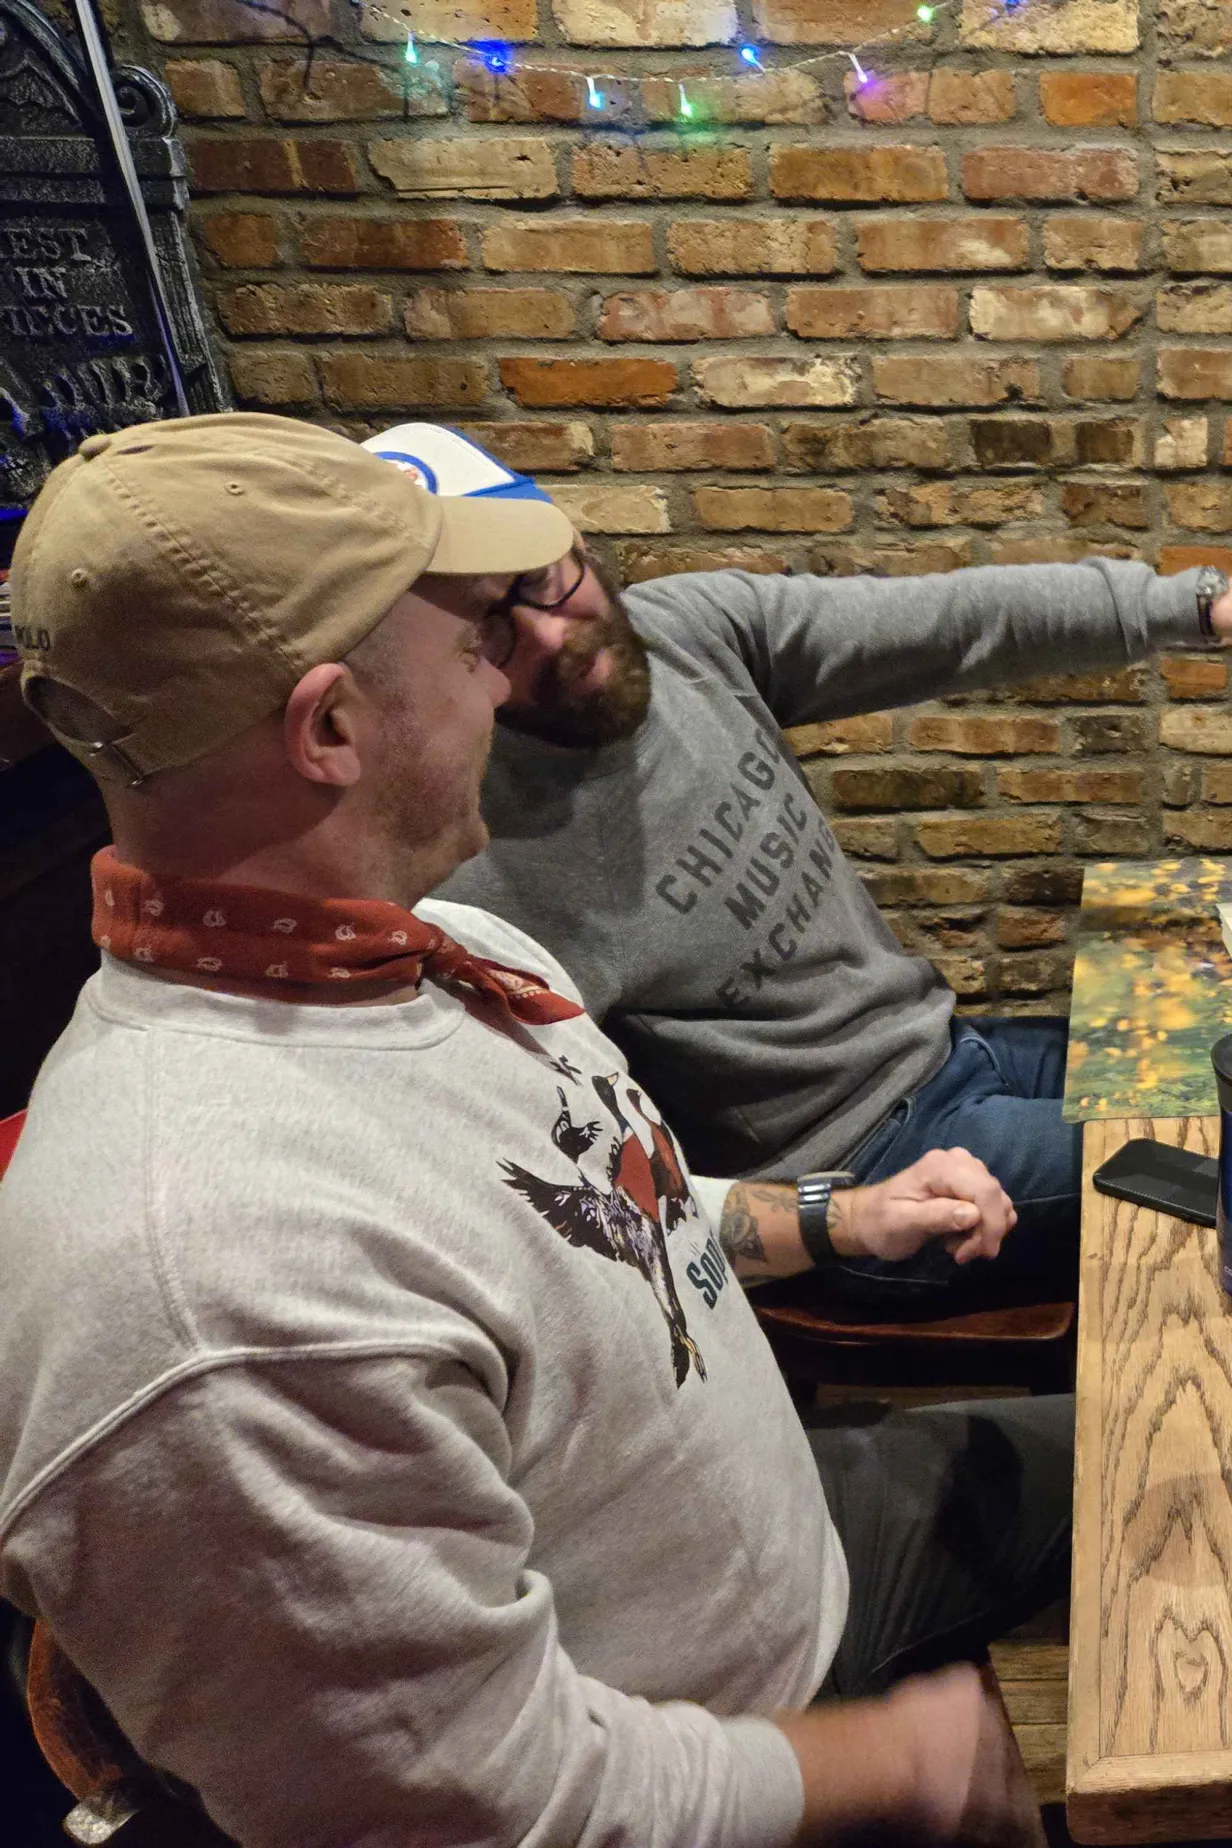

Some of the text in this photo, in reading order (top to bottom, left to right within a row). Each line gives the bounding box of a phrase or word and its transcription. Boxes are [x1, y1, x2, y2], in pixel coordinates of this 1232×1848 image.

[0, 227, 92, 261] EST
[14, 266, 68, 299] IN
[0, 303, 133, 336] IECES
[723, 792, 808, 930] MUSIC
[715, 819, 837, 1008] EXCHANG
